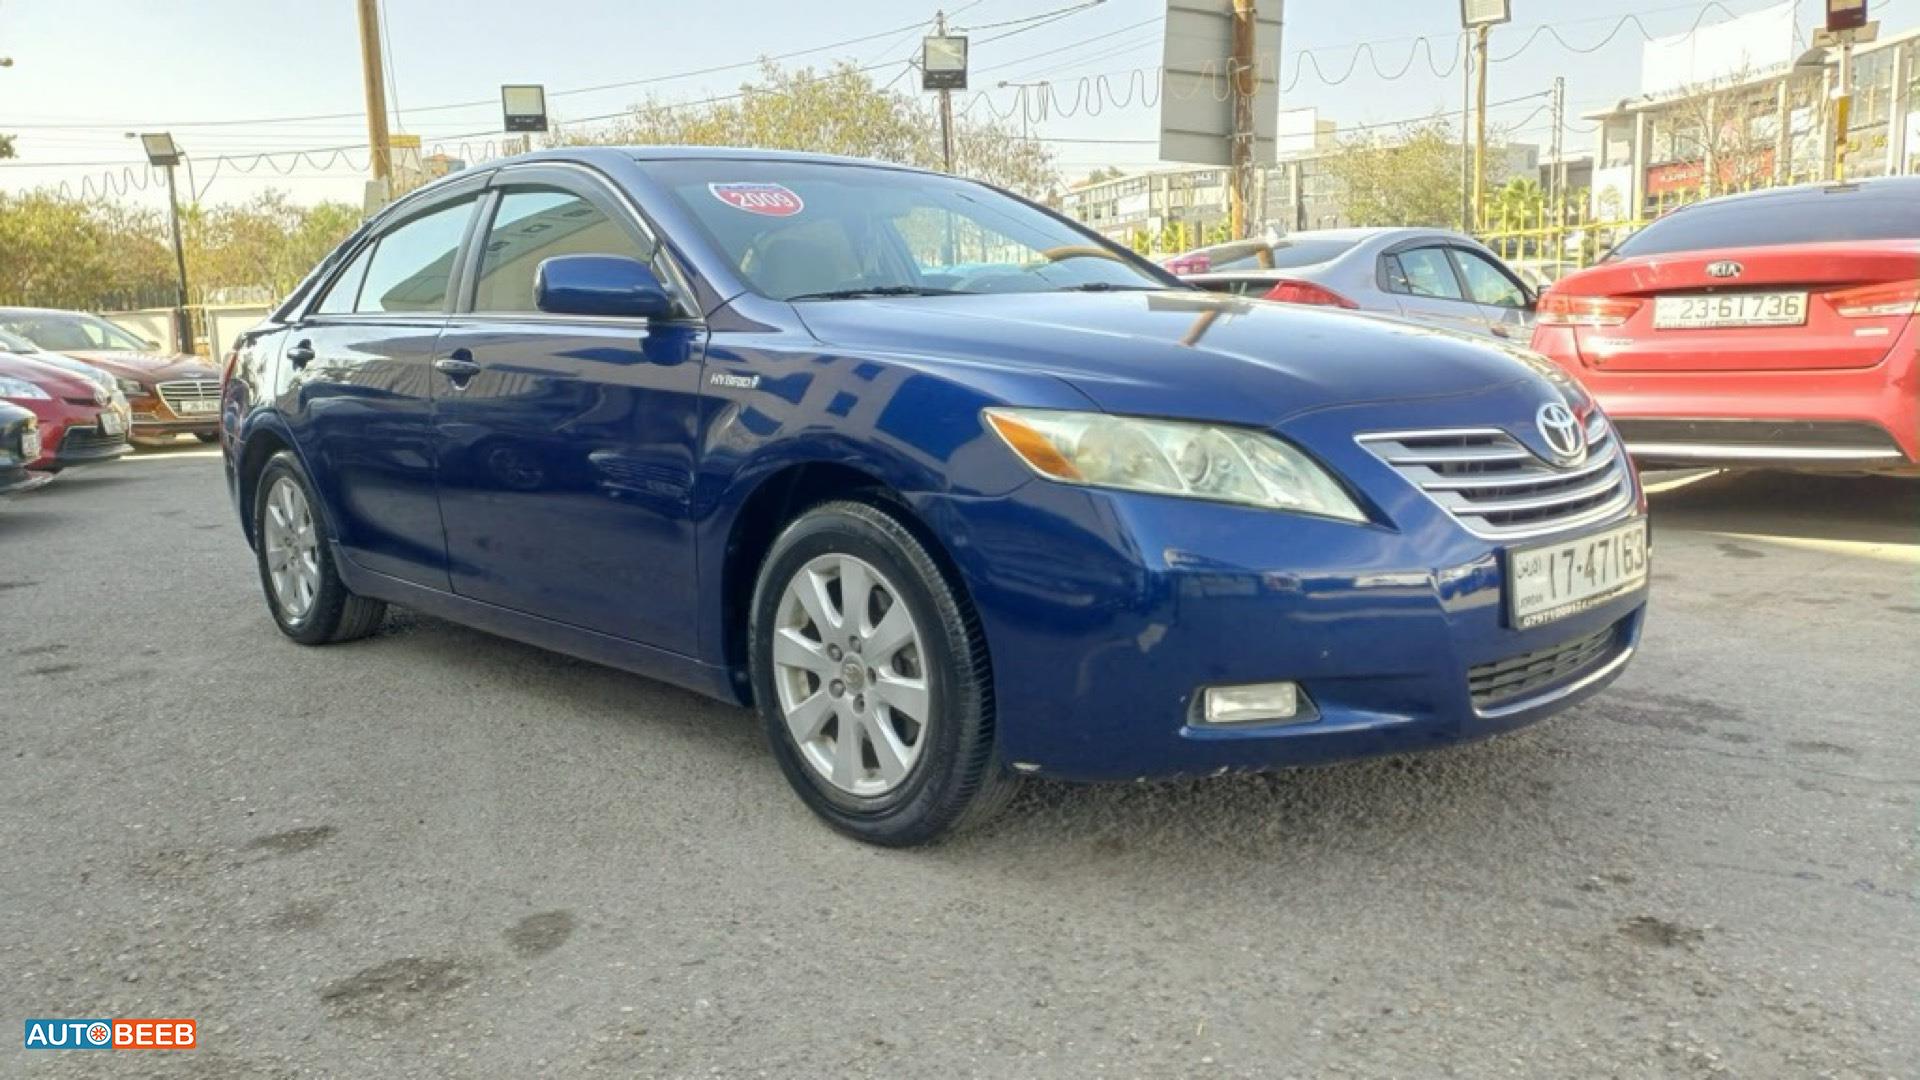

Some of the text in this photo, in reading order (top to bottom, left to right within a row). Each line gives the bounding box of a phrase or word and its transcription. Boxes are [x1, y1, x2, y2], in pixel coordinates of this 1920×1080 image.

[729, 192, 795, 208] 2009
[1710, 263, 1739, 277] KIA
[1679, 295, 1800, 320] 23-61736
[1548, 528, 1643, 600] 17-47163
